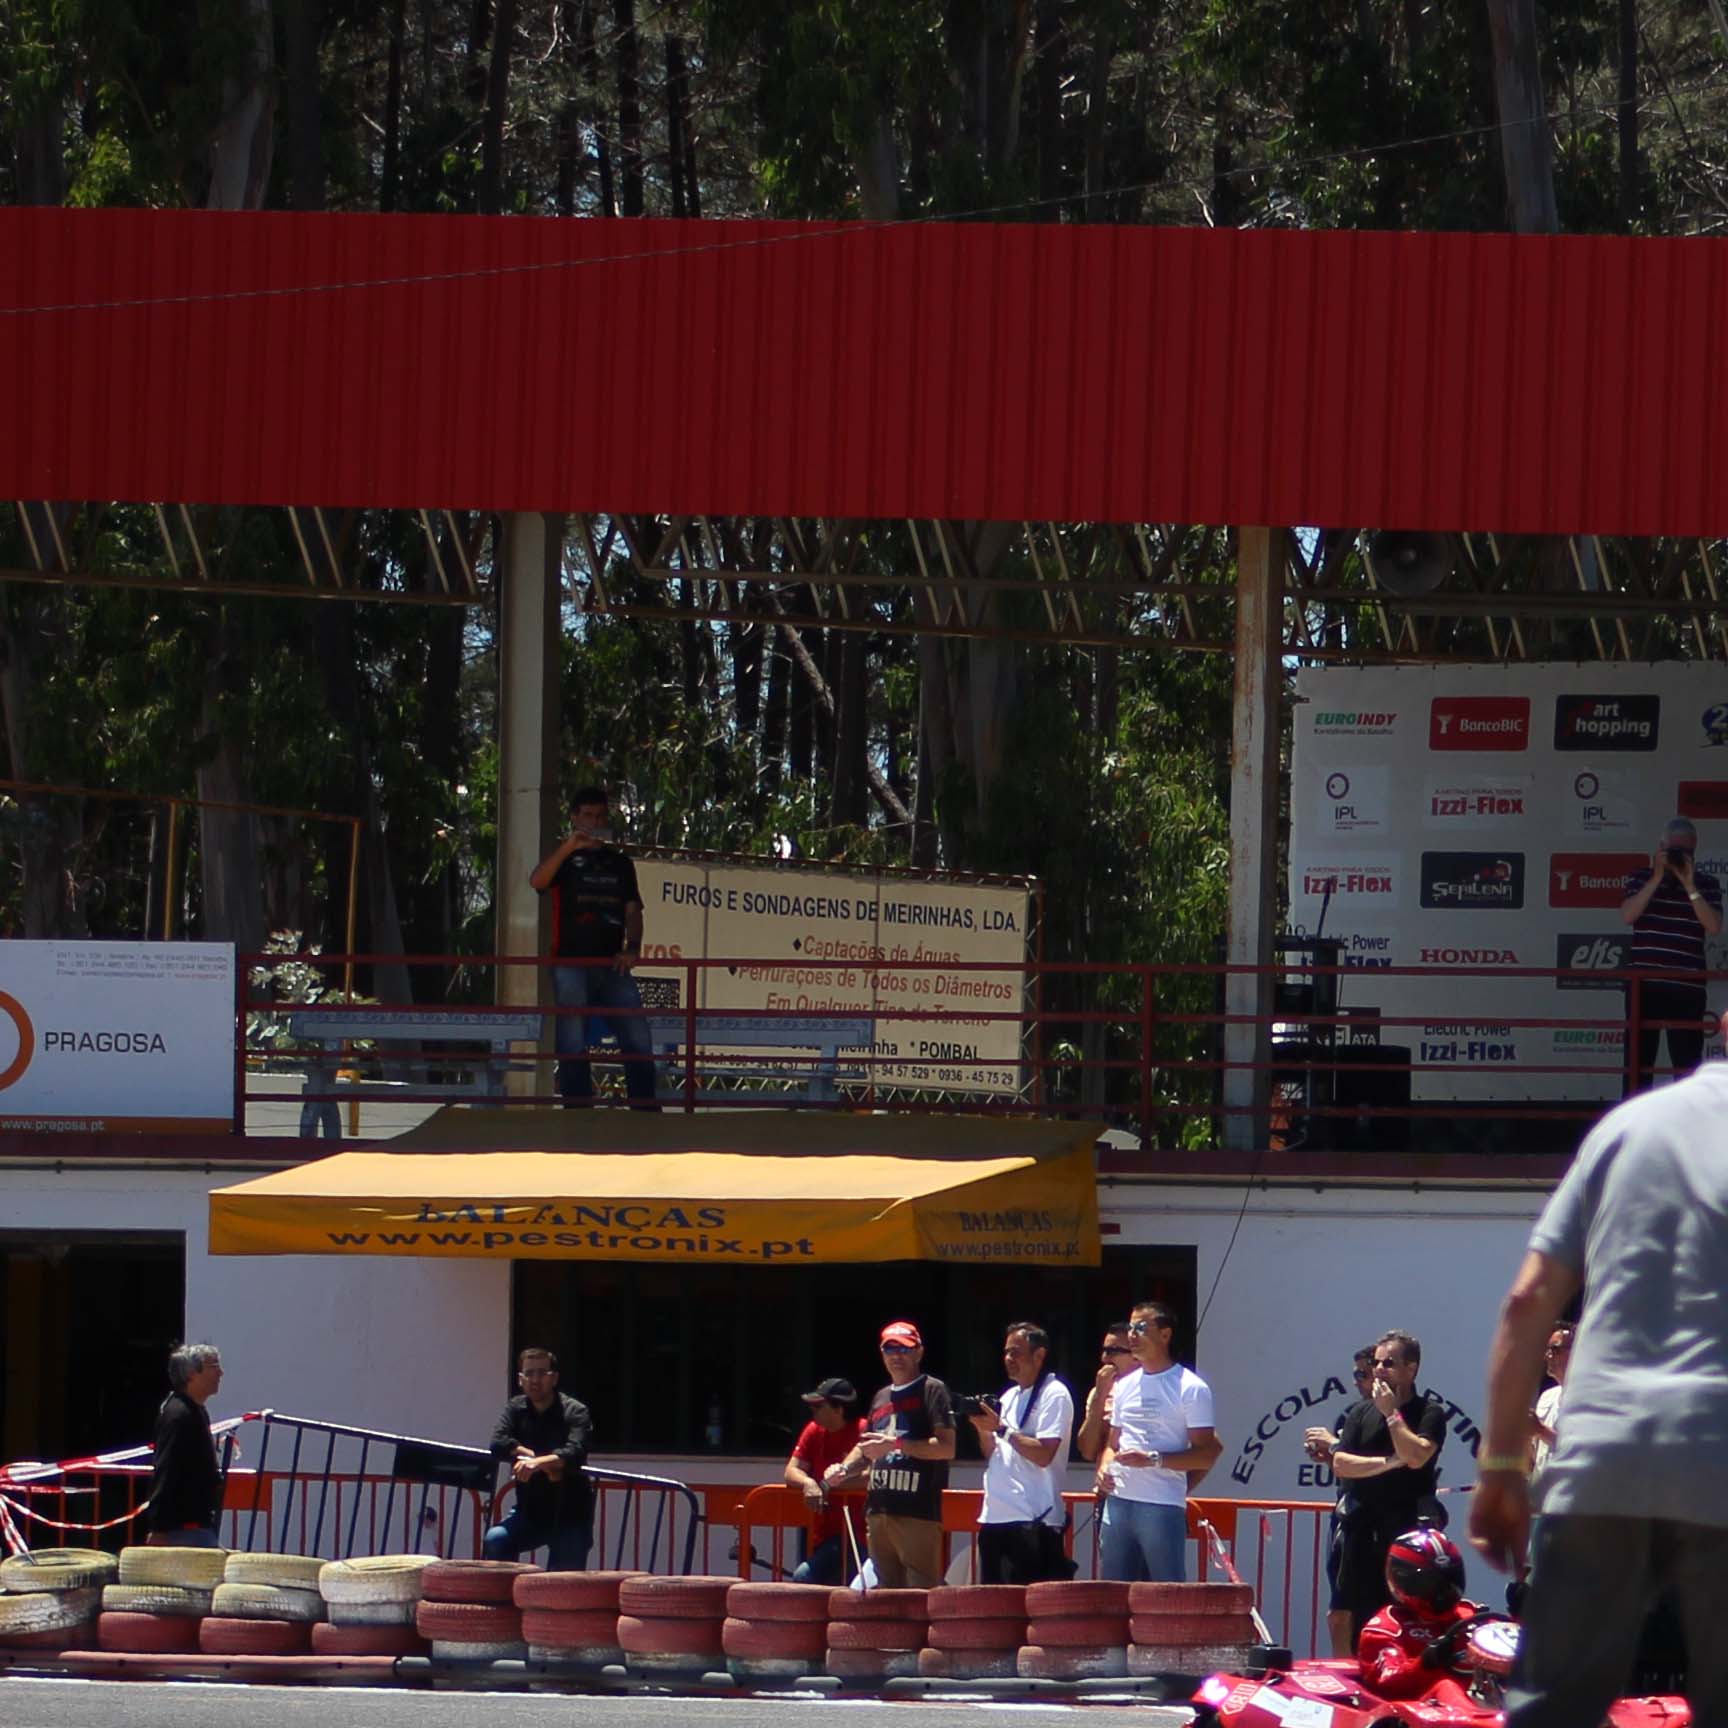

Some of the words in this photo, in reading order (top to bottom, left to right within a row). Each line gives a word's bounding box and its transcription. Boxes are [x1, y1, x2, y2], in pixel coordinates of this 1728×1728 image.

[1315, 712, 1397, 726] EUROINDY
[1593, 703, 1618, 717] art
[1459, 719, 1523, 733] BancoBIC
[1575, 717, 1651, 738] hopping
[1431, 796, 1524, 816] Izzi-Flex
[1303, 875, 1393, 895] Izzi-Flex
[661, 881, 722, 911] FUROS
[726, 892, 738, 911] E
[743, 891, 851, 923] SONDAGENS
[855, 901, 880, 923] DE
[883, 903, 979, 933] MEIRINHAS,
[983, 909, 1022, 934] LDA.
[803, 935, 886, 964] Captações
[891, 942, 909, 962] de
[1352, 934, 1391, 950] Power
[1419, 948, 1519, 964] HONDA
[836, 968, 857, 989] de
[860, 972, 908, 995] Todos
[912, 977, 930, 995] os
[44, 1031, 167, 1054] PRAGOSA
[1553, 1030, 1626, 1044] EUROIND
[919, 1041, 981, 1060] POMBAL
[1420, 1041, 1517, 1062] Izzi-Flex
[1, 1117, 105, 1132] www.pragosa.pt
[414, 1202, 726, 1231] BALANÇAS
[327, 1226, 815, 1258] www.pestronix.pt
[935, 1239, 1080, 1261] www.pestronix.pt
[1231, 1376, 1348, 1486] ESCOLA
